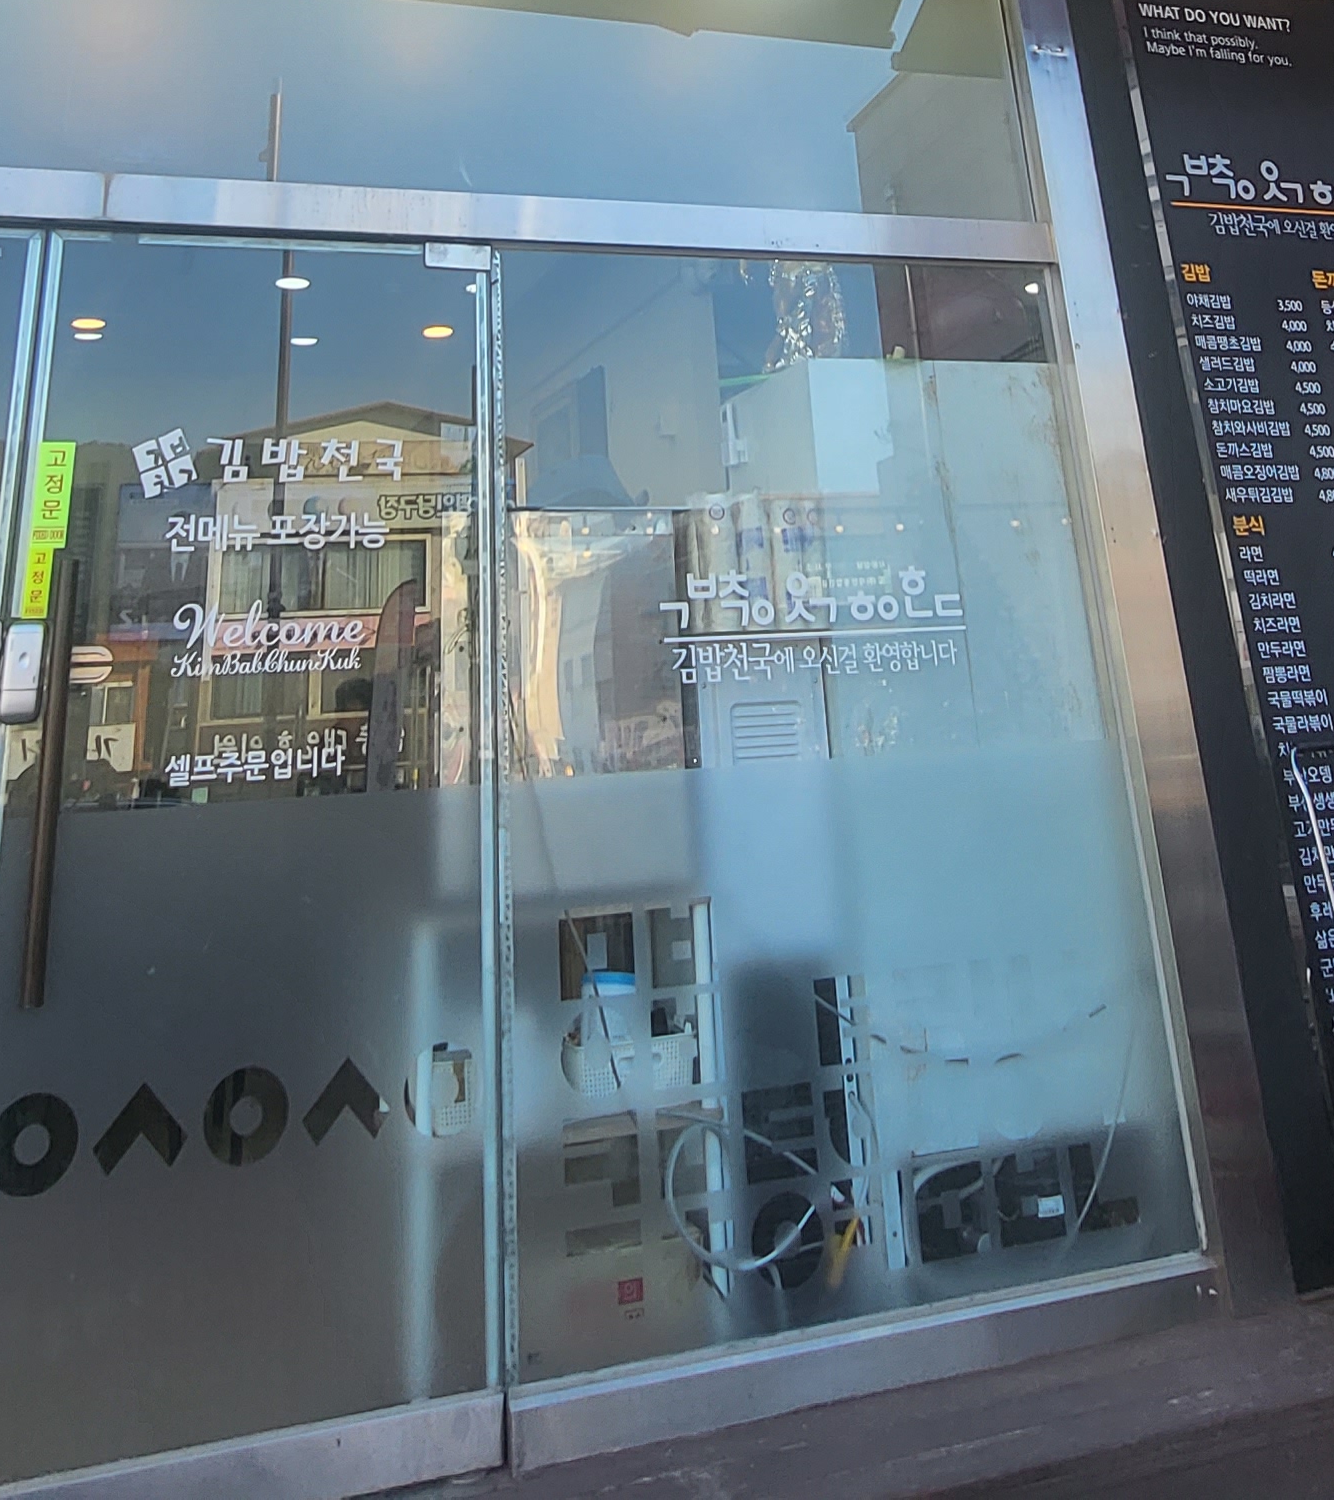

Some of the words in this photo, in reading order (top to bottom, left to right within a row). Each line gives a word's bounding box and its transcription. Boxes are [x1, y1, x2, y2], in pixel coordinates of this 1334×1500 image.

[1139, 3, 1180, 22] WHAT
[1184, 8, 1206, 24] DO
[1209, 10, 1240, 28] YOU
[1243, 13, 1291, 32] WANT?
[1150, 27, 1182, 43] think
[1184, 32, 1207, 46] that
[1147, 41, 1186, 59] Maybe
[1210, 46, 1246, 66] falling
[1248, 50, 1265, 65] for
[1181, 264, 1211, 282] 김밥
[1277, 299, 1303, 312] 3,500
[1282, 320, 1307, 332] 4,000
[1286, 341, 1312, 353] 4,000
[1291, 361, 1316, 373] 4,000
[1204, 378, 1260, 393] 소고기김밥
[1296, 382, 1321, 395] 4,500
[1300, 403, 1326, 416] 4,500
[1305, 425, 1331, 437] 4,500
[207, 438, 404, 484] 김밥천국
[1309, 446, 1334, 459] 4,500
[41, 450, 67, 520] 고정문
[166, 517, 260, 553] 전메뉴
[267, 513, 389, 550] 포장가능
[1233, 516, 1265, 536] 분식
[1239, 547, 1264, 562] 라면
[30, 552, 47, 603] 고정문
[1244, 570, 1280, 586] 떡라면
[1249, 593, 1296, 610] 김치라면
[173, 600, 366, 649] Welcome
[1254, 617, 1301, 634] 치즈라면
[1258, 641, 1307, 658] 만두라면
[672, 642, 795, 684] 김밥천국에
[799, 644, 859, 675] 오신걸
[862, 639, 957, 673] 환영합니다
[1268, 689, 1328, 708] 국물떡볶이
[1273, 714, 1334, 734] 국물라볶이
[166, 747, 346, 787] 셀프주문입니다
